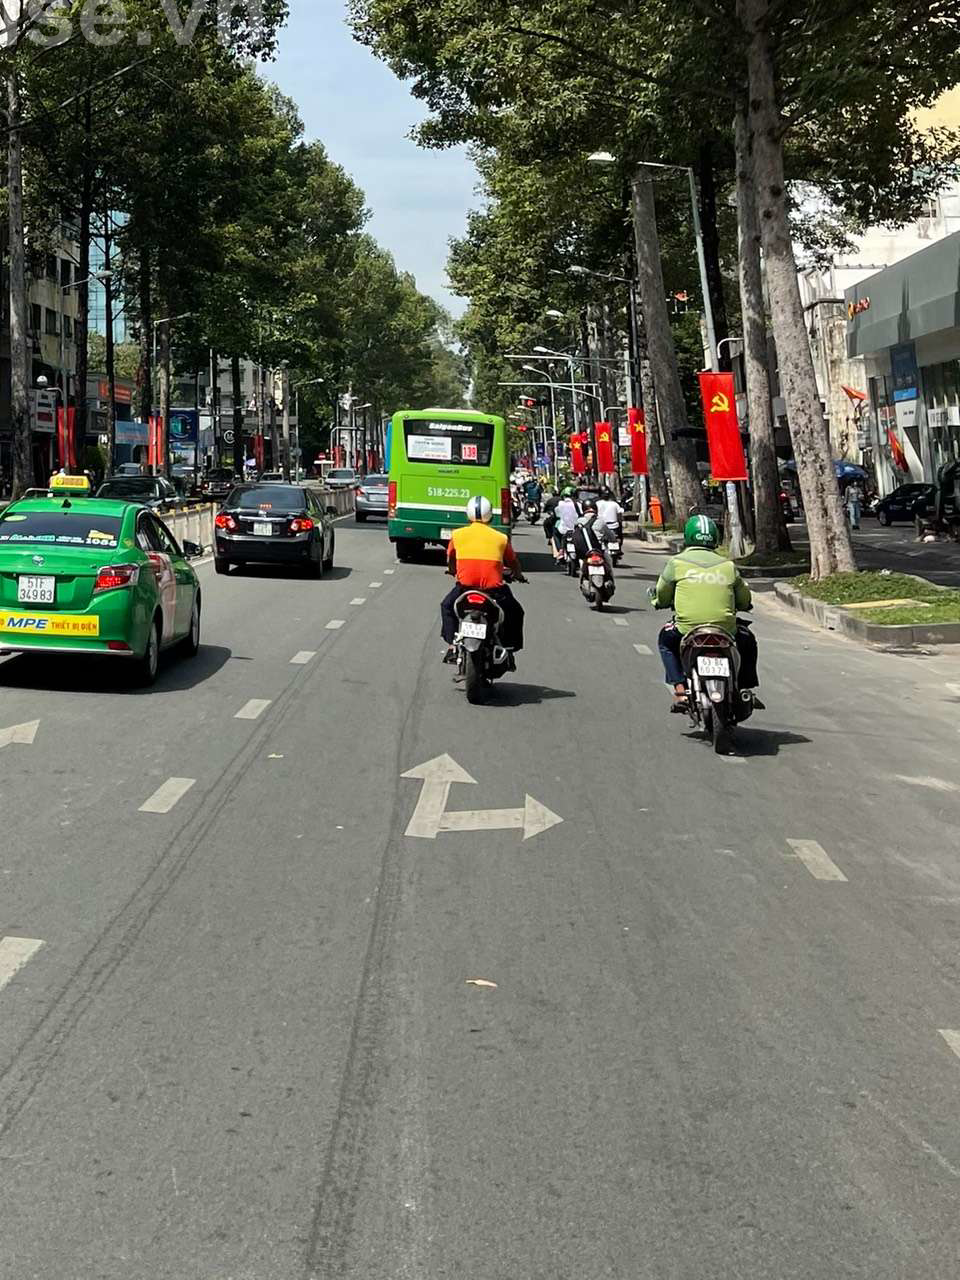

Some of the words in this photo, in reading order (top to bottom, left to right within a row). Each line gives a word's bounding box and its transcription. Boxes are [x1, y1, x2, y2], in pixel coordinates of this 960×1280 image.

[462, 446, 476, 459] 139
[695, 533, 714, 542] Grab
[685, 569, 728, 585] Grab
[7, 617, 49, 629] MPE
